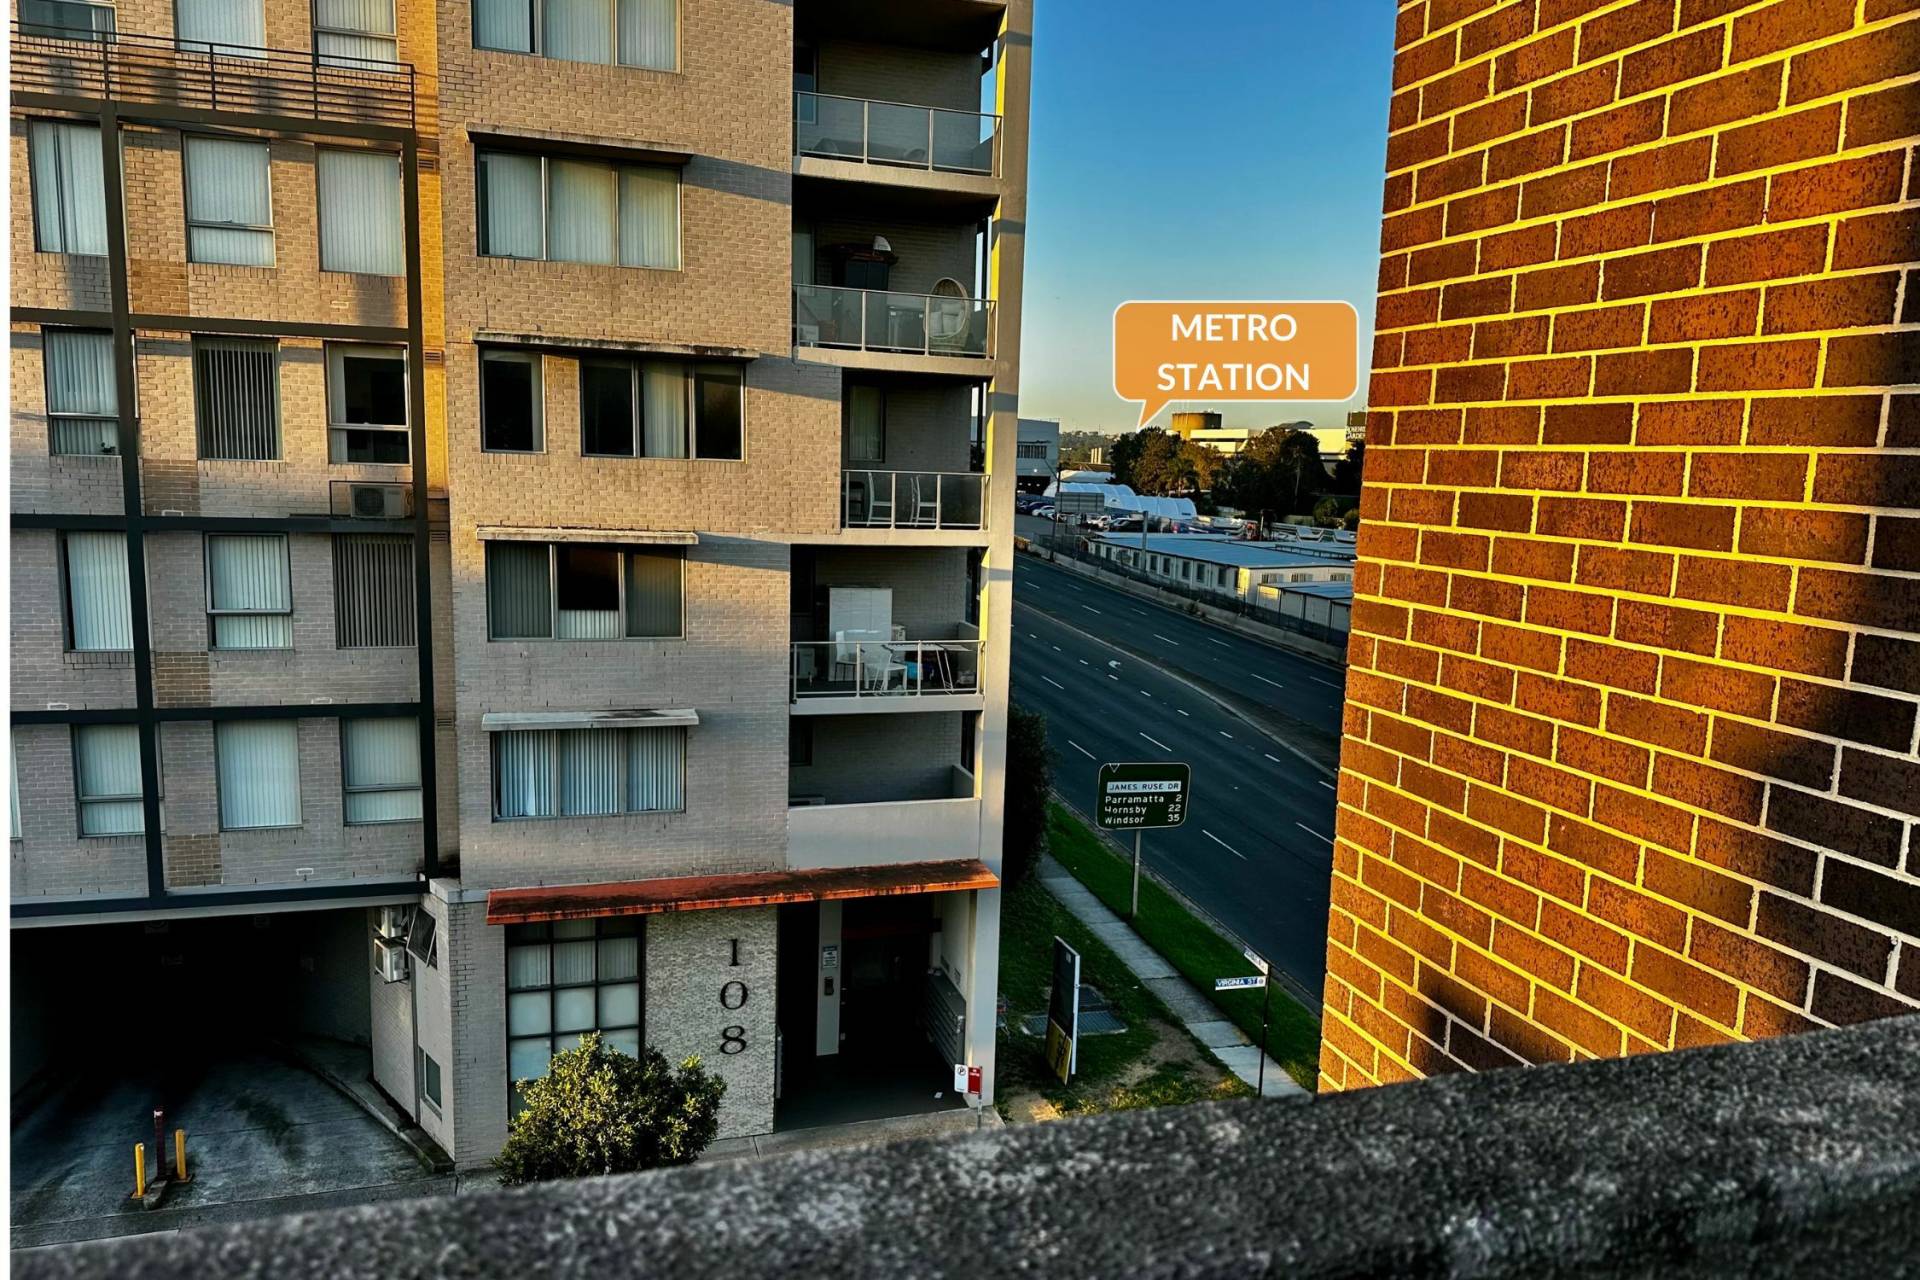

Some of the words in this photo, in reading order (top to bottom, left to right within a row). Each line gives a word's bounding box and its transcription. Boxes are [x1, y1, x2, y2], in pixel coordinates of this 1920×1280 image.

[1109, 783, 1138, 791] JAMES
[1105, 795, 1164, 804] Parramatta
[1175, 794, 1182, 802] 2
[1104, 806, 1147, 815] Hornsby
[1168, 804, 1181, 812] 22
[1105, 816, 1144, 824] Windsor
[1167, 814, 1180, 822] 35
[1217, 979, 1245, 987] VIRGINIA
[720, 938, 748, 1055] 108
